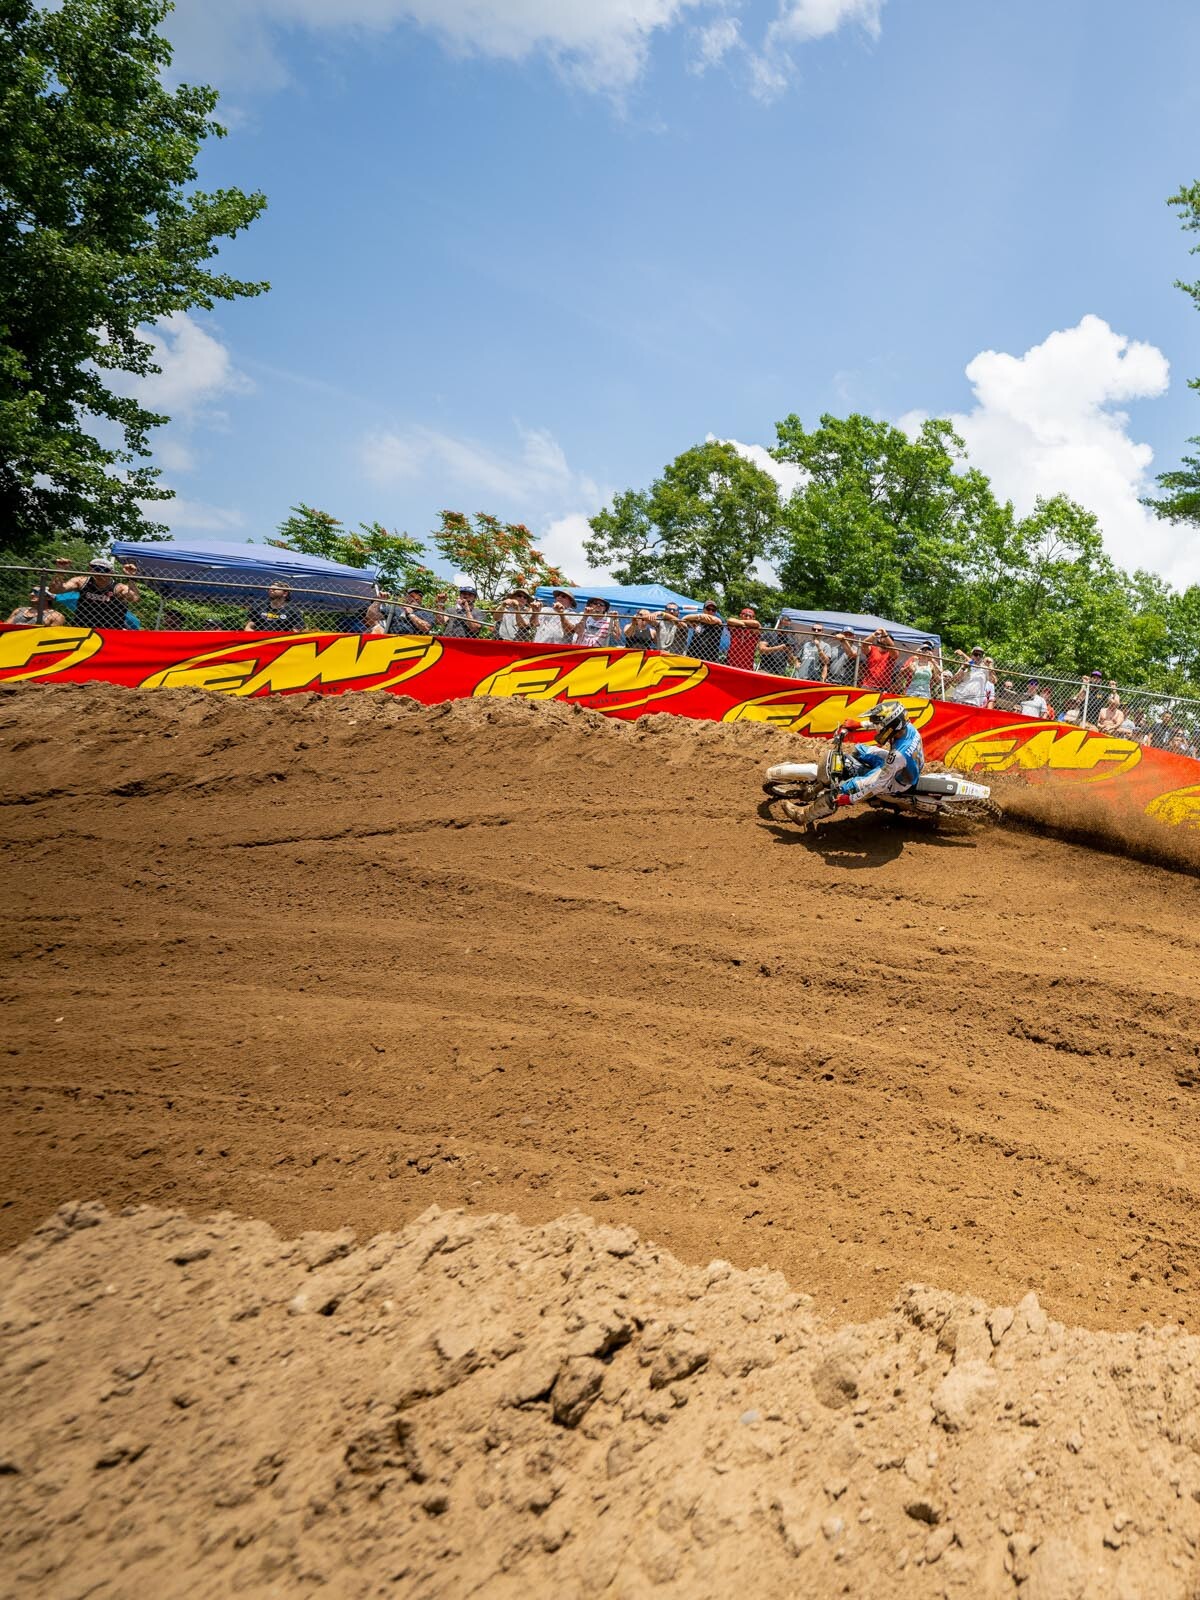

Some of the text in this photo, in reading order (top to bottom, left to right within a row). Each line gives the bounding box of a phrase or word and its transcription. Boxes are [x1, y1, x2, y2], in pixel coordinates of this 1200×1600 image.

[160, 633, 435, 697] FMF
[488, 651, 704, 700] FMF
[951, 729, 1141, 771] FMF
